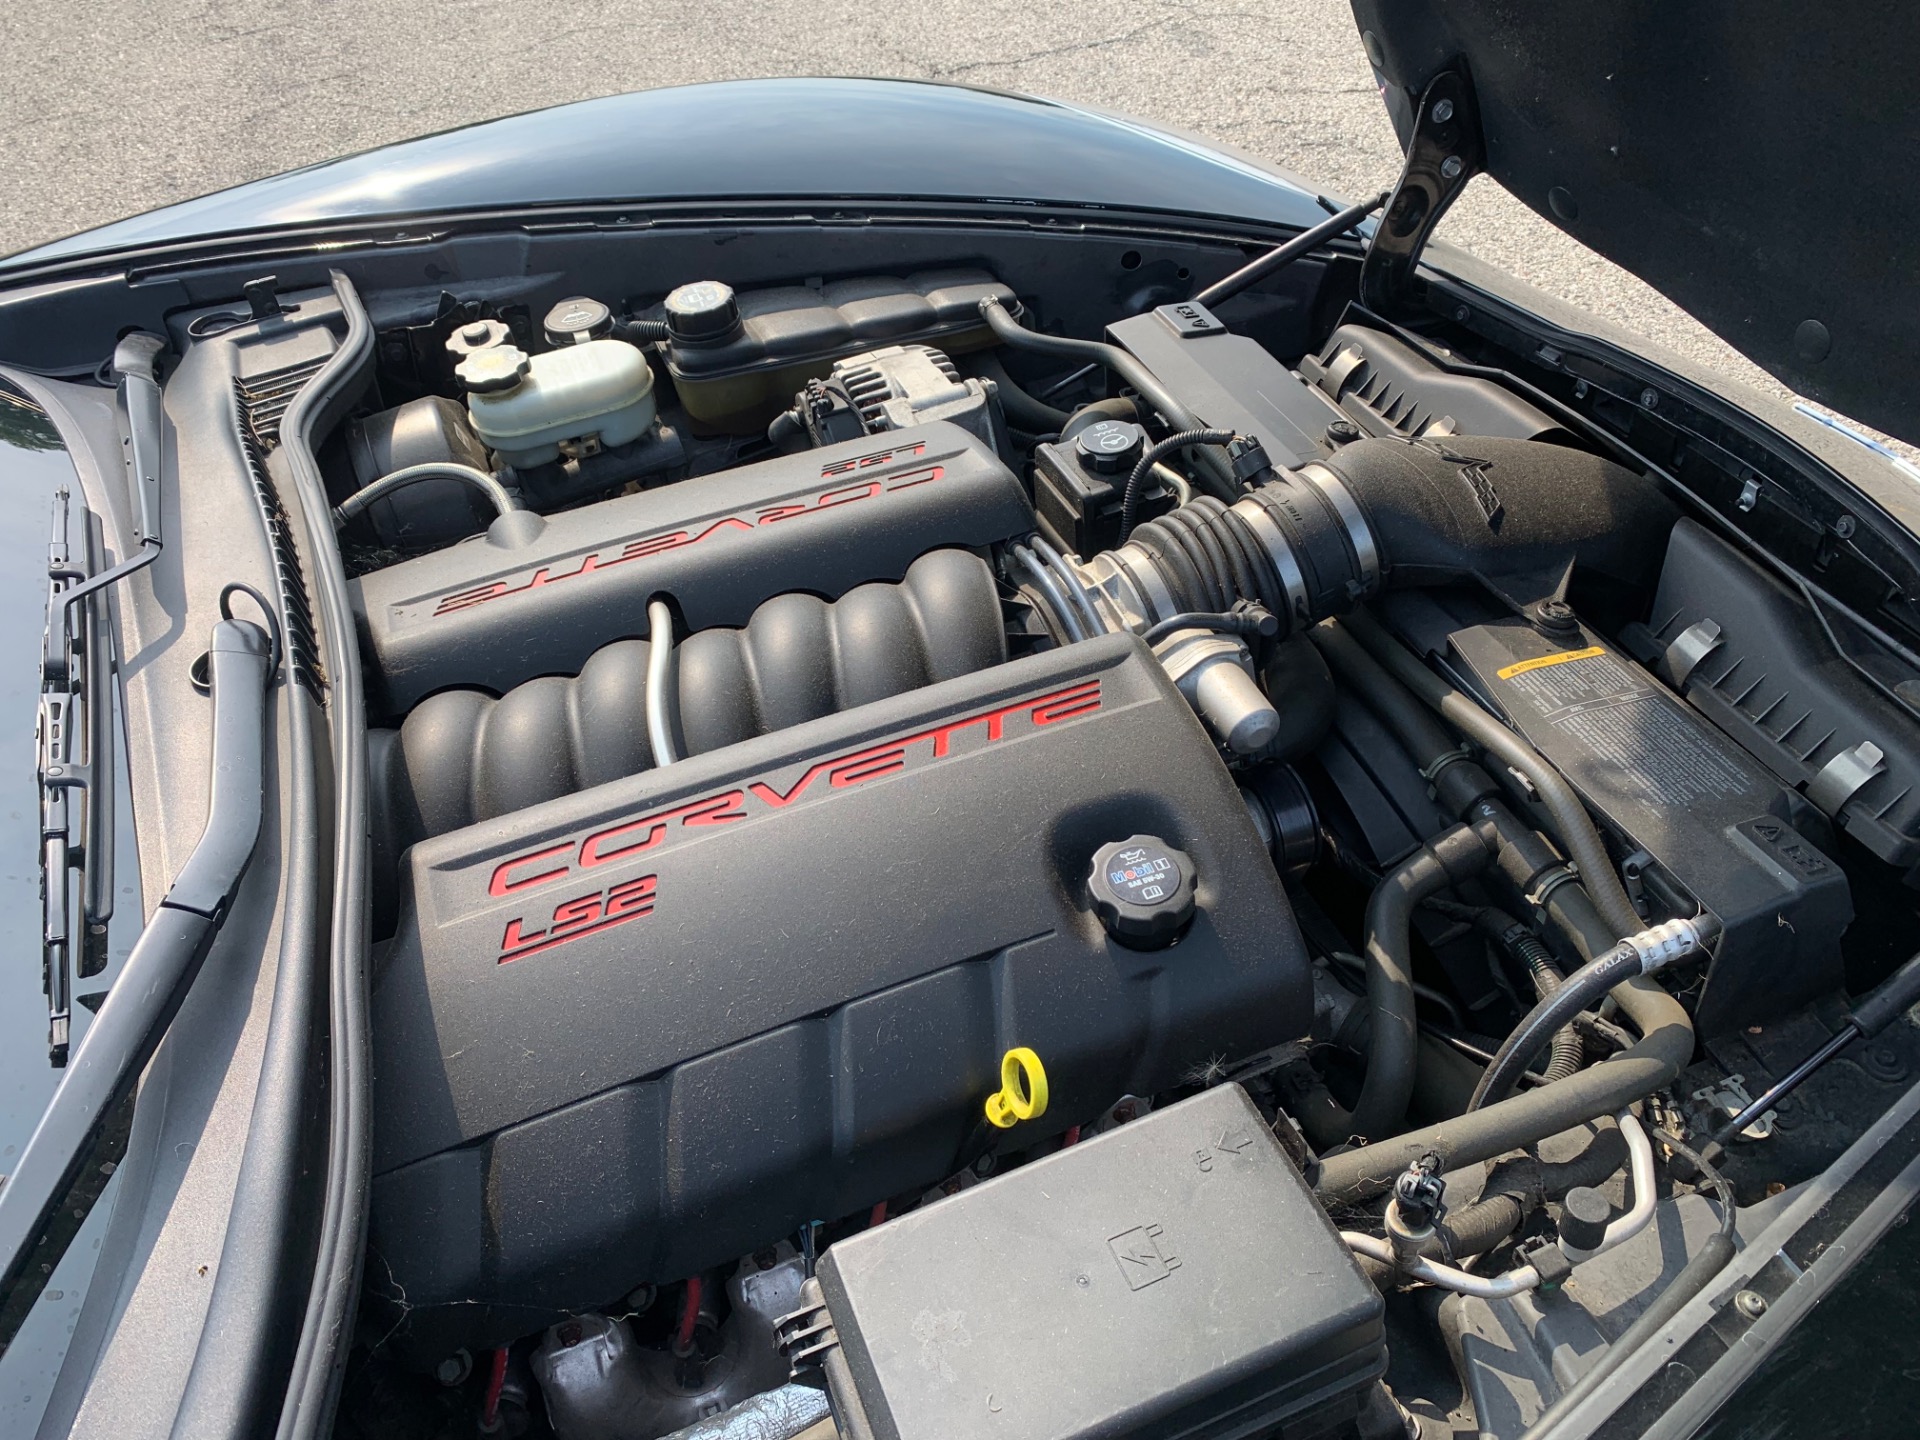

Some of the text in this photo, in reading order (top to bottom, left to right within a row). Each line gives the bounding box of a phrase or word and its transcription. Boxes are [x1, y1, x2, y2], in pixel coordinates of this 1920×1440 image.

[820, 443, 926, 478] LS2
[433, 465, 945, 617] CORVETTE
[488, 680, 1102, 897] CORVETTE
[1111, 863, 1154, 884] Mobil
[501, 874, 658, 952] LS2
